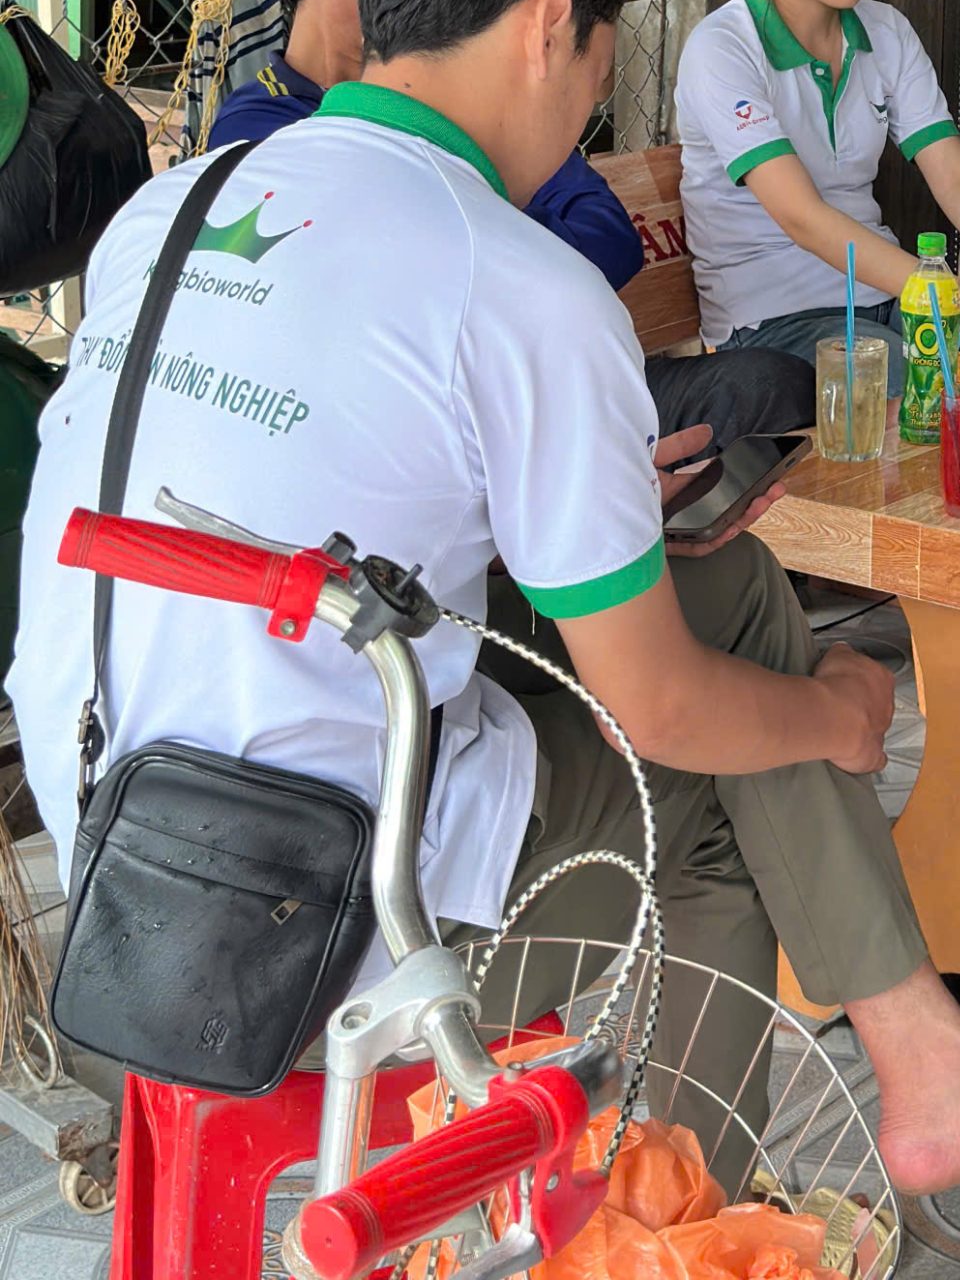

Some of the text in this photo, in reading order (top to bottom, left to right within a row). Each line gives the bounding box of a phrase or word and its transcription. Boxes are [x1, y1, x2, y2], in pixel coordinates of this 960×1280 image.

[142, 259, 274, 306] Kgbioworld
[159, 351, 215, 401] NÔNG
[212, 371, 311, 437] NGHIỆP
